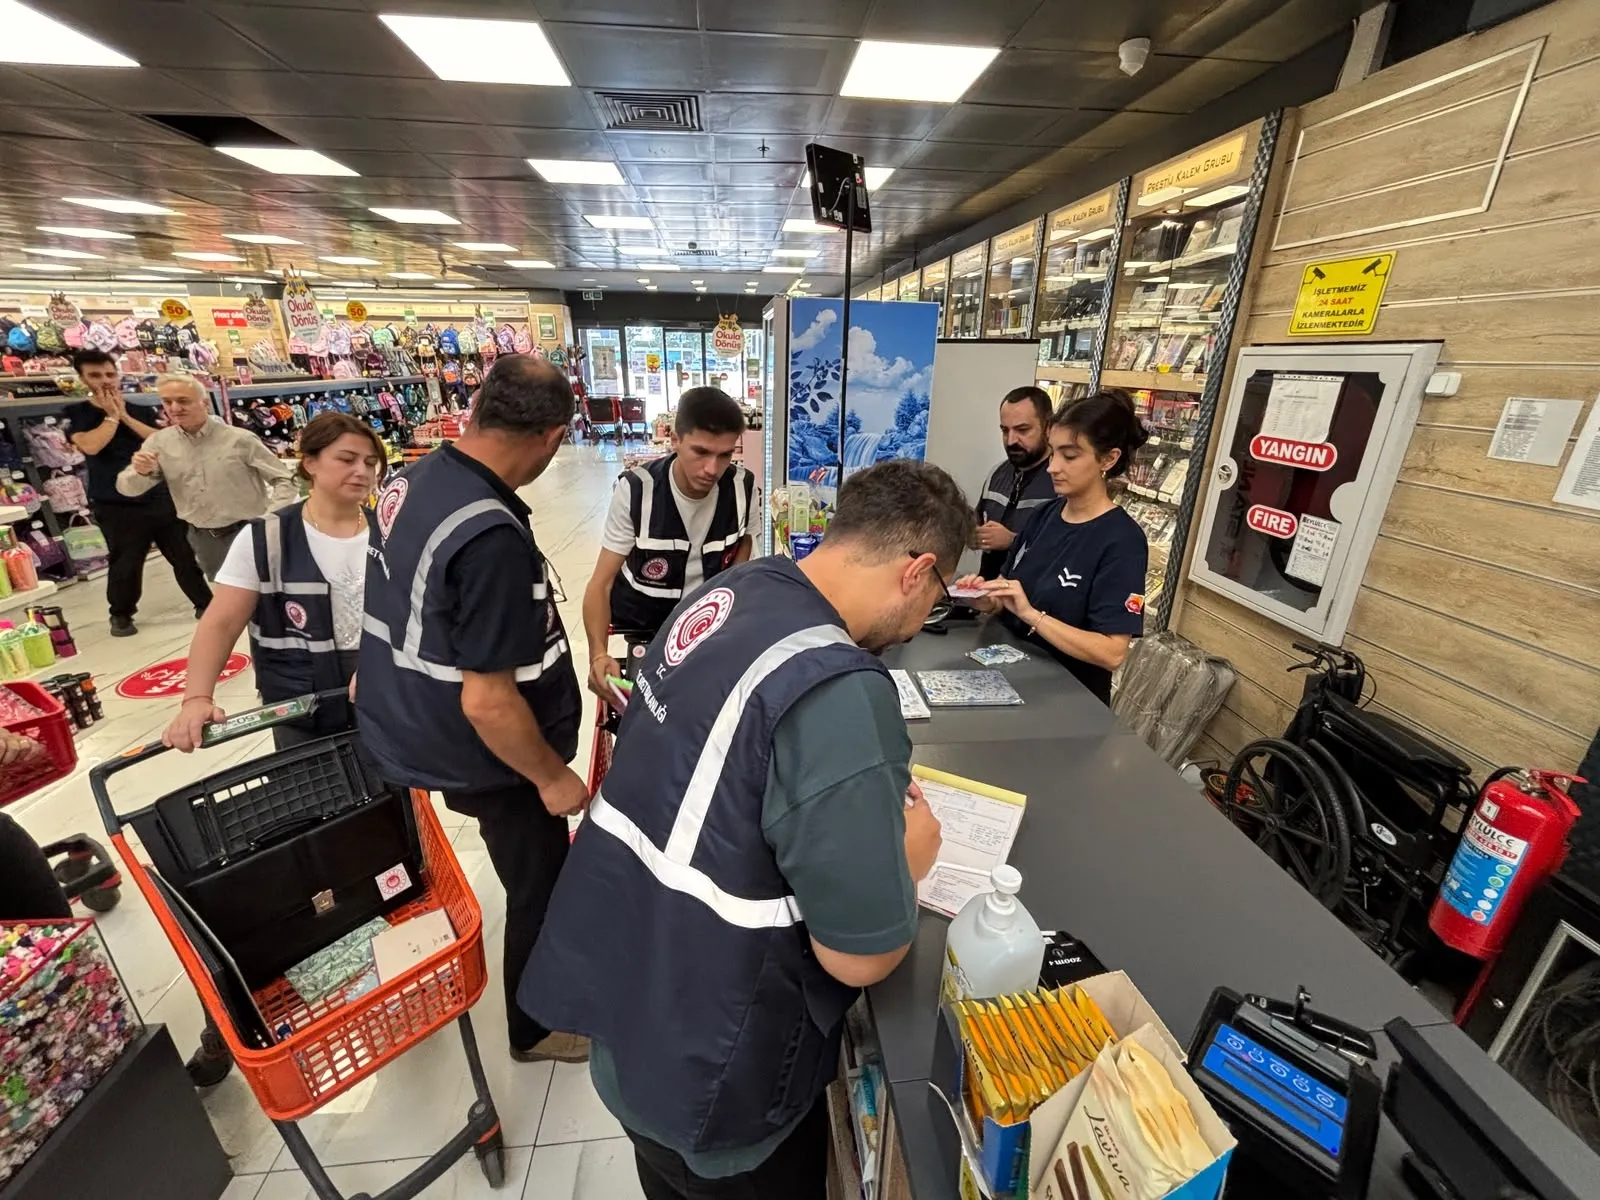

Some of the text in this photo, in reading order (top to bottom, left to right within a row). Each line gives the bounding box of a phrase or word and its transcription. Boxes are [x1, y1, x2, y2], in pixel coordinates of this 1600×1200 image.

[1176, 165, 1201, 182] KALEM
[1203, 152, 1233, 172] GRUBU
[1313, 283, 1368, 296] İŞLETMEMİZ
[288, 299, 313, 313] Okula
[1330, 297, 1354, 306] SAAT
[1302, 308, 1365, 318] KAMERALARLA
[1296, 319, 1365, 330] İZLENMEKTEDİR
[716, 330, 740, 340] Okula
[1260, 440, 1327, 465] YANGIN
[1252, 510, 1292, 533] FIRE
